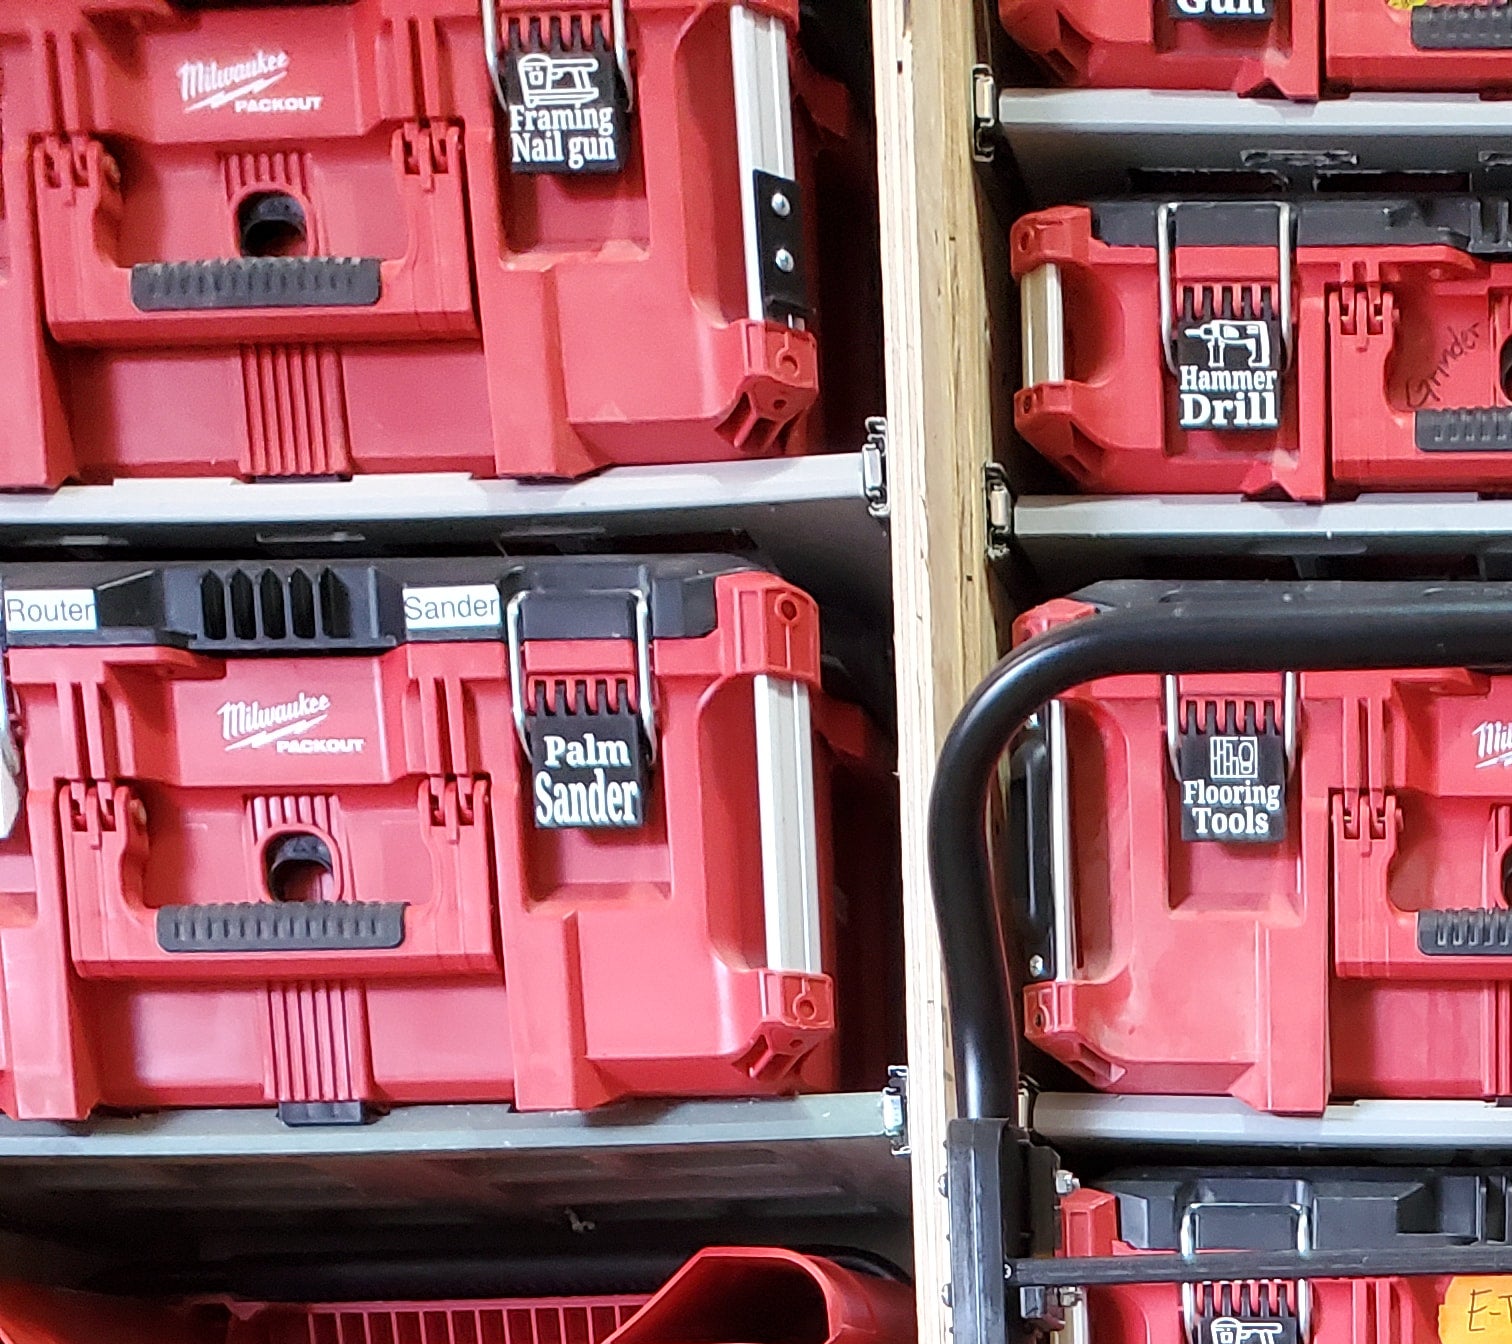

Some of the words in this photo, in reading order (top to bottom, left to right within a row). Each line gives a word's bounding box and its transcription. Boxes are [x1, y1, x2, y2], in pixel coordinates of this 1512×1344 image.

[176, 49, 290, 101] Milwaukee
[234, 96, 323, 112] PACKOUT
[509, 105, 614, 136] Framing
[511, 131, 564, 163] Nail
[568, 136, 616, 169] gun
[1179, 365, 1278, 391] Hammer
[1180, 391, 1278, 427] Drill
[6, 598, 95, 622] Router
[404, 594, 497, 620] Sander
[217, 692, 331, 741] Milwaukee
[276, 738, 364, 753] PACKOUT
[543, 732, 632, 768] Palm
[535, 768, 640, 826] Sander
[1183, 779, 1281, 811] Flooring
[1191, 806, 1269, 835] Tools
